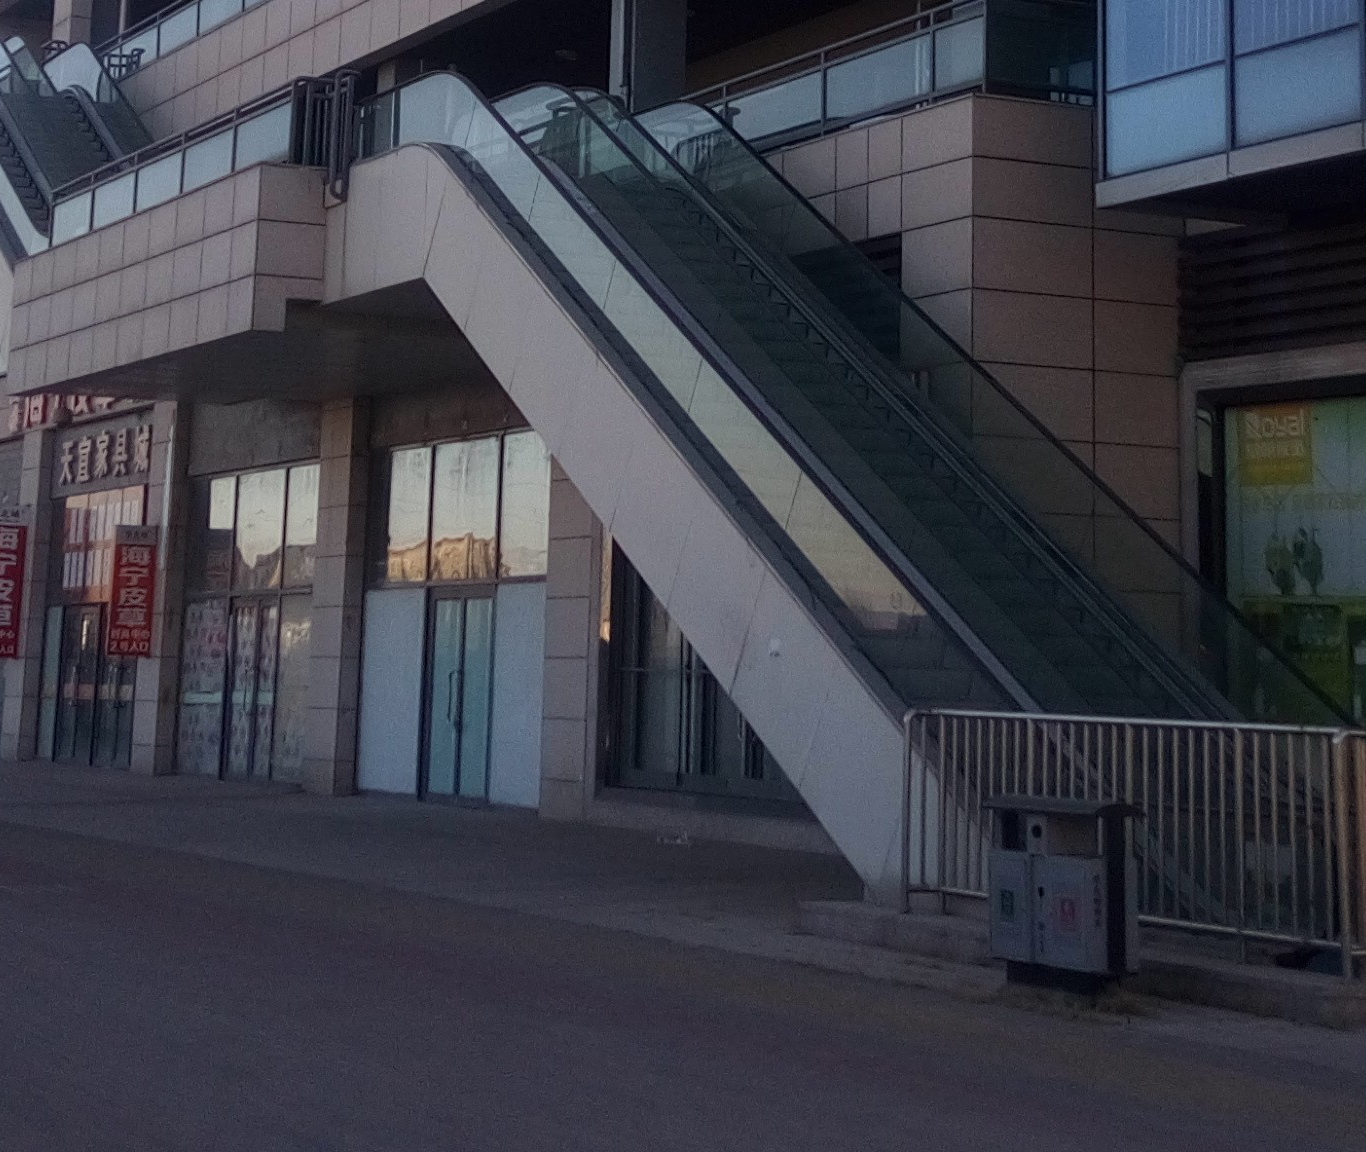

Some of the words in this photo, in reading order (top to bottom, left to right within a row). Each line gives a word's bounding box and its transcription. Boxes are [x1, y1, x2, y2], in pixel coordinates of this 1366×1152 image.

[1245, 407, 1304, 438] Royal
[116, 546, 151, 627] 海宁皮草
